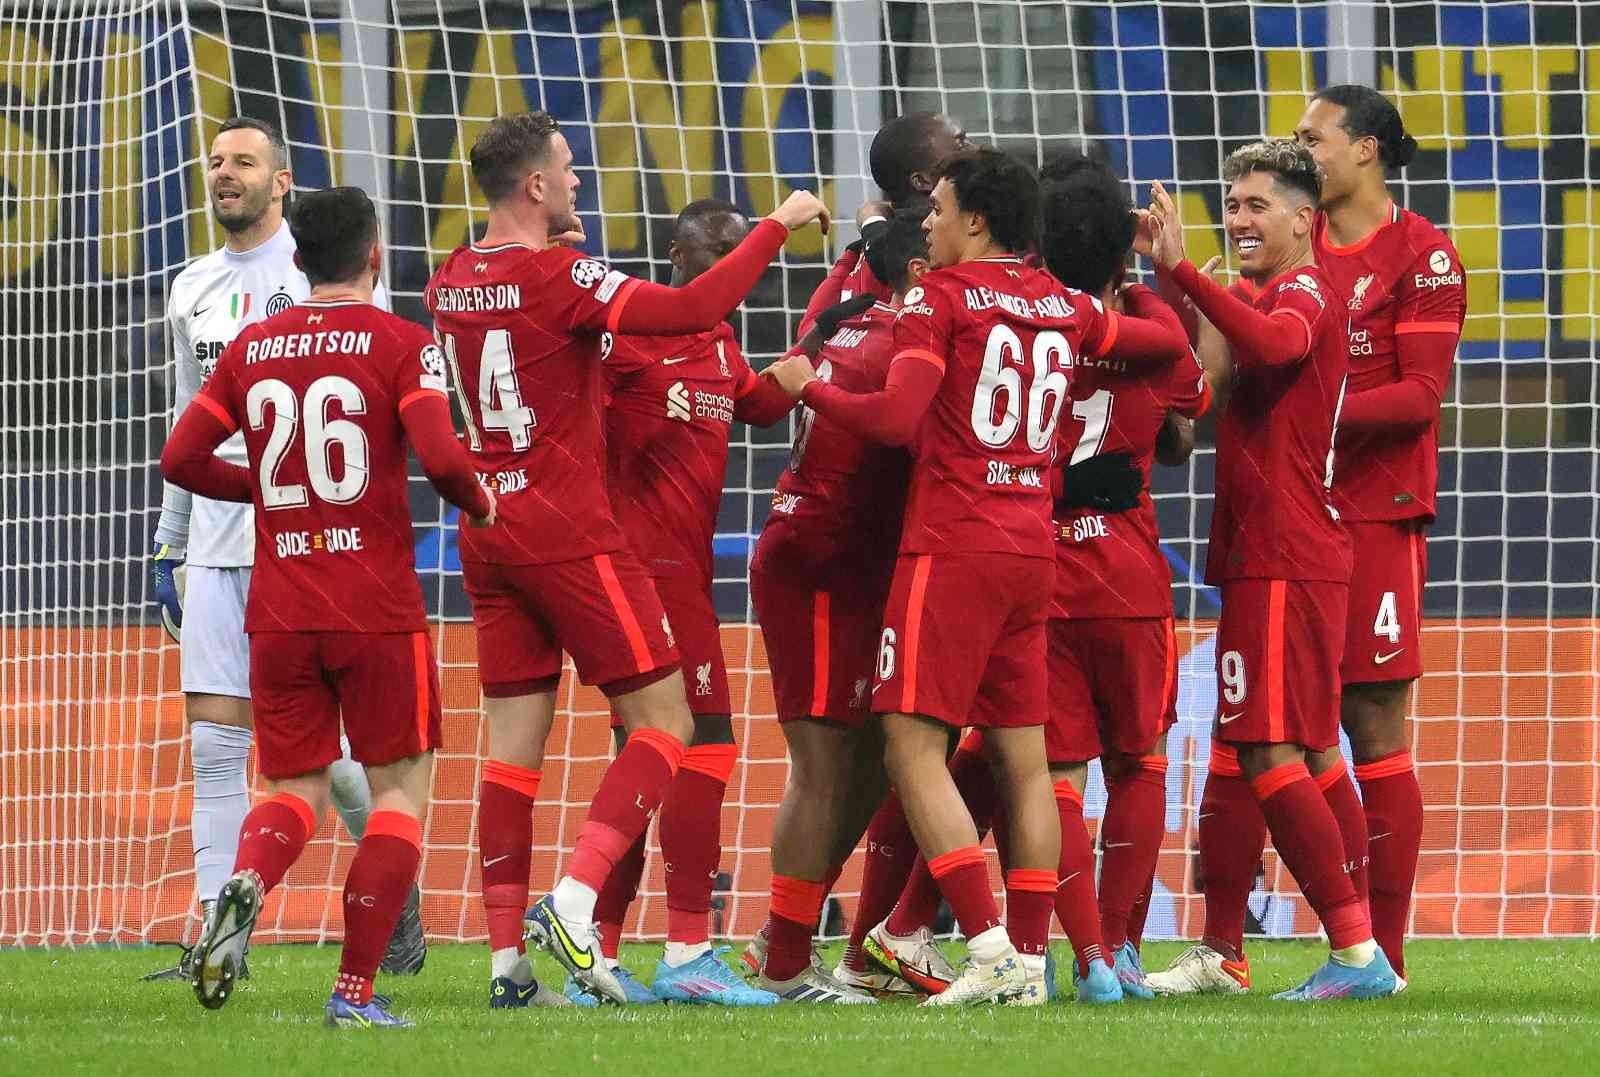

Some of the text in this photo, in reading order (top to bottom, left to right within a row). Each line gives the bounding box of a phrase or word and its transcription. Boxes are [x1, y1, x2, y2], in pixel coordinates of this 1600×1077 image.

[435, 284, 520, 311] HENDERSON
[1279, 282, 1326, 310] Expedia
[1415, 273, 1462, 291] Expedia
[246, 331, 372, 364] ROBERTSON
[444, 329, 537, 452] 14
[971, 323, 1073, 453] 66
[246, 375, 370, 511] 26
[496, 469, 528, 495] SIDE
[275, 531, 311, 559] SIDE
[323, 527, 363, 553] SIDE
[1073, 515, 1110, 542] SIDE
[1374, 591, 1401, 644] 4
[1221, 650, 1247, 705] 9
